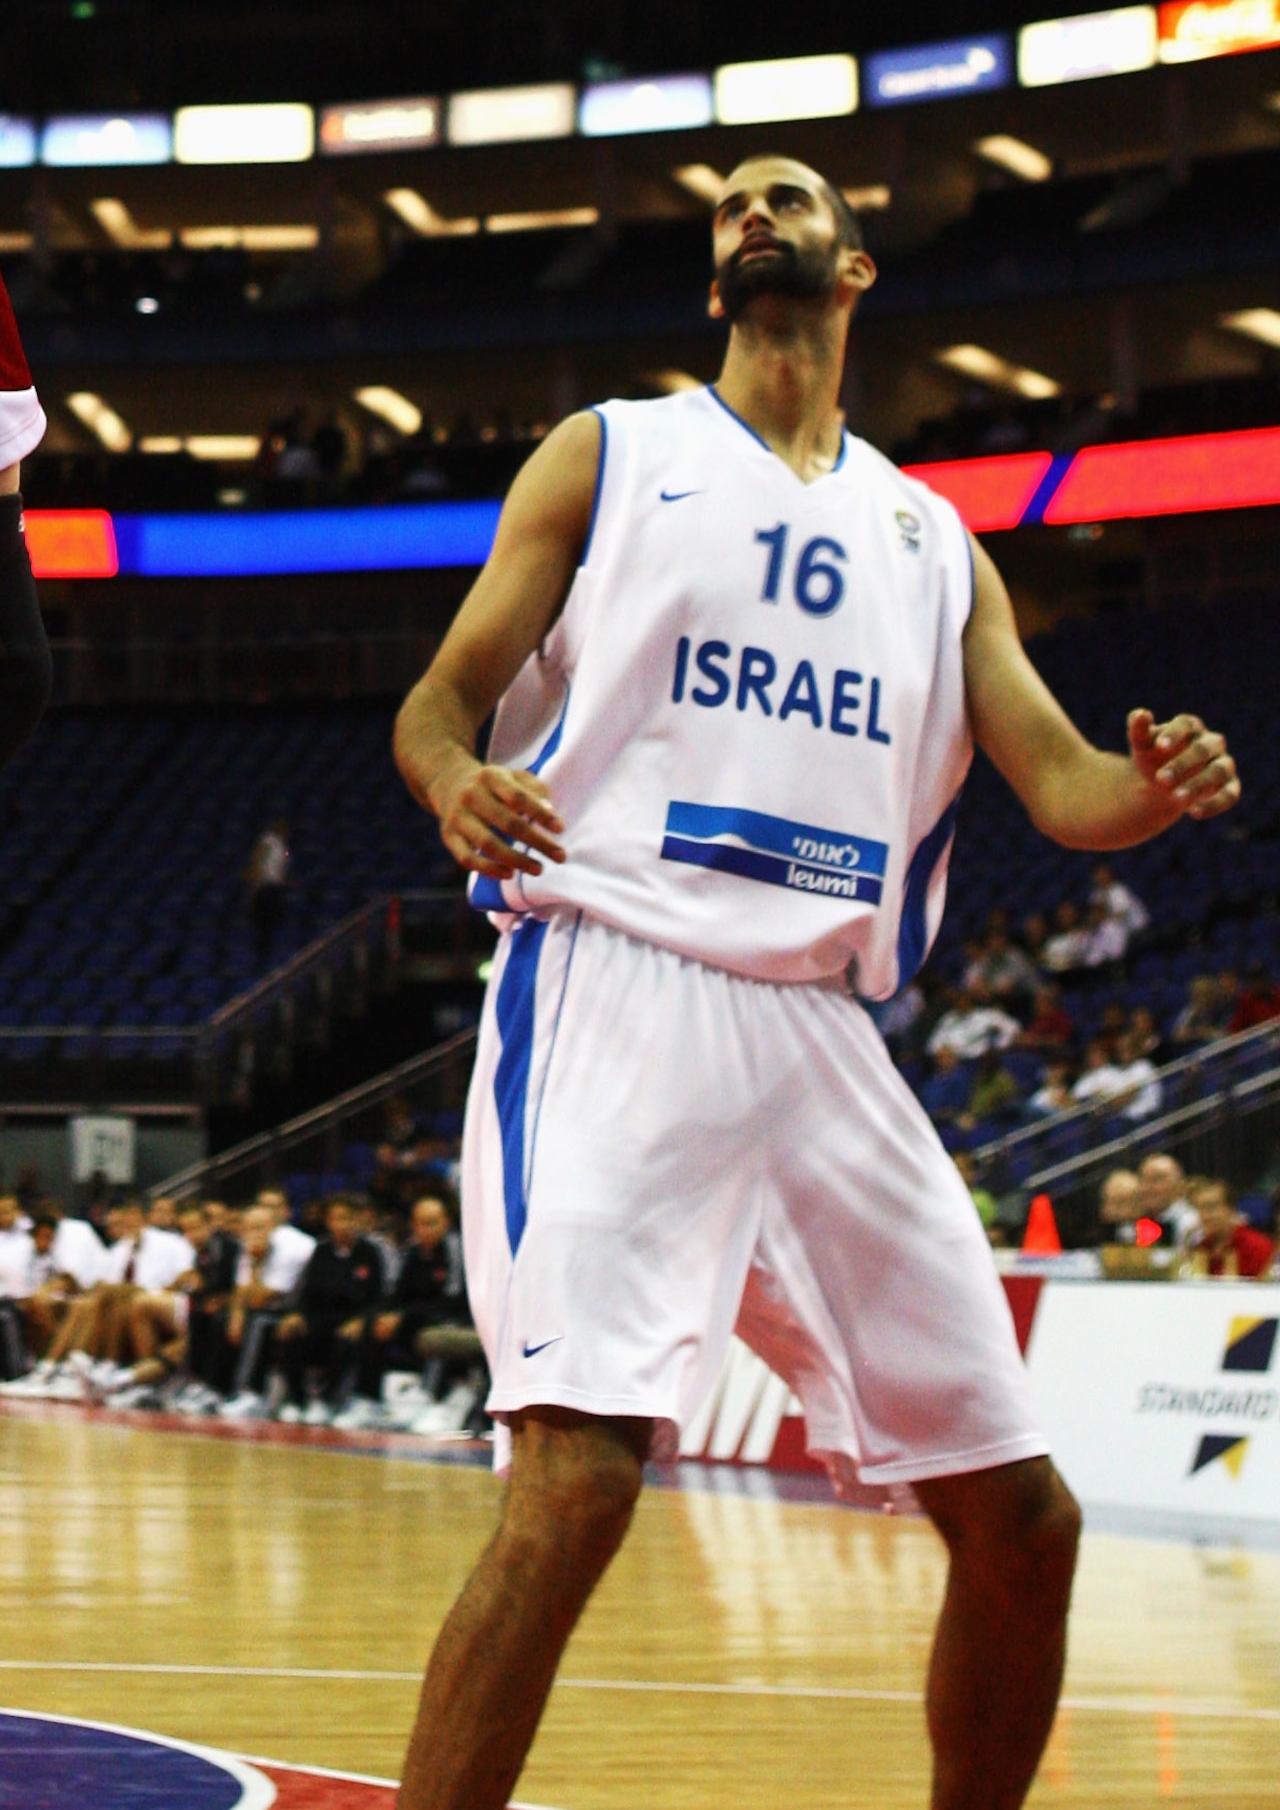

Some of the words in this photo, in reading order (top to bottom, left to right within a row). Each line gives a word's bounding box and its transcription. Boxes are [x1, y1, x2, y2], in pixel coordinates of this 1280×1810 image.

[754, 521, 851, 620] 16
[671, 636, 892, 745] ISRAEL
[786, 862, 858, 897] leumi
